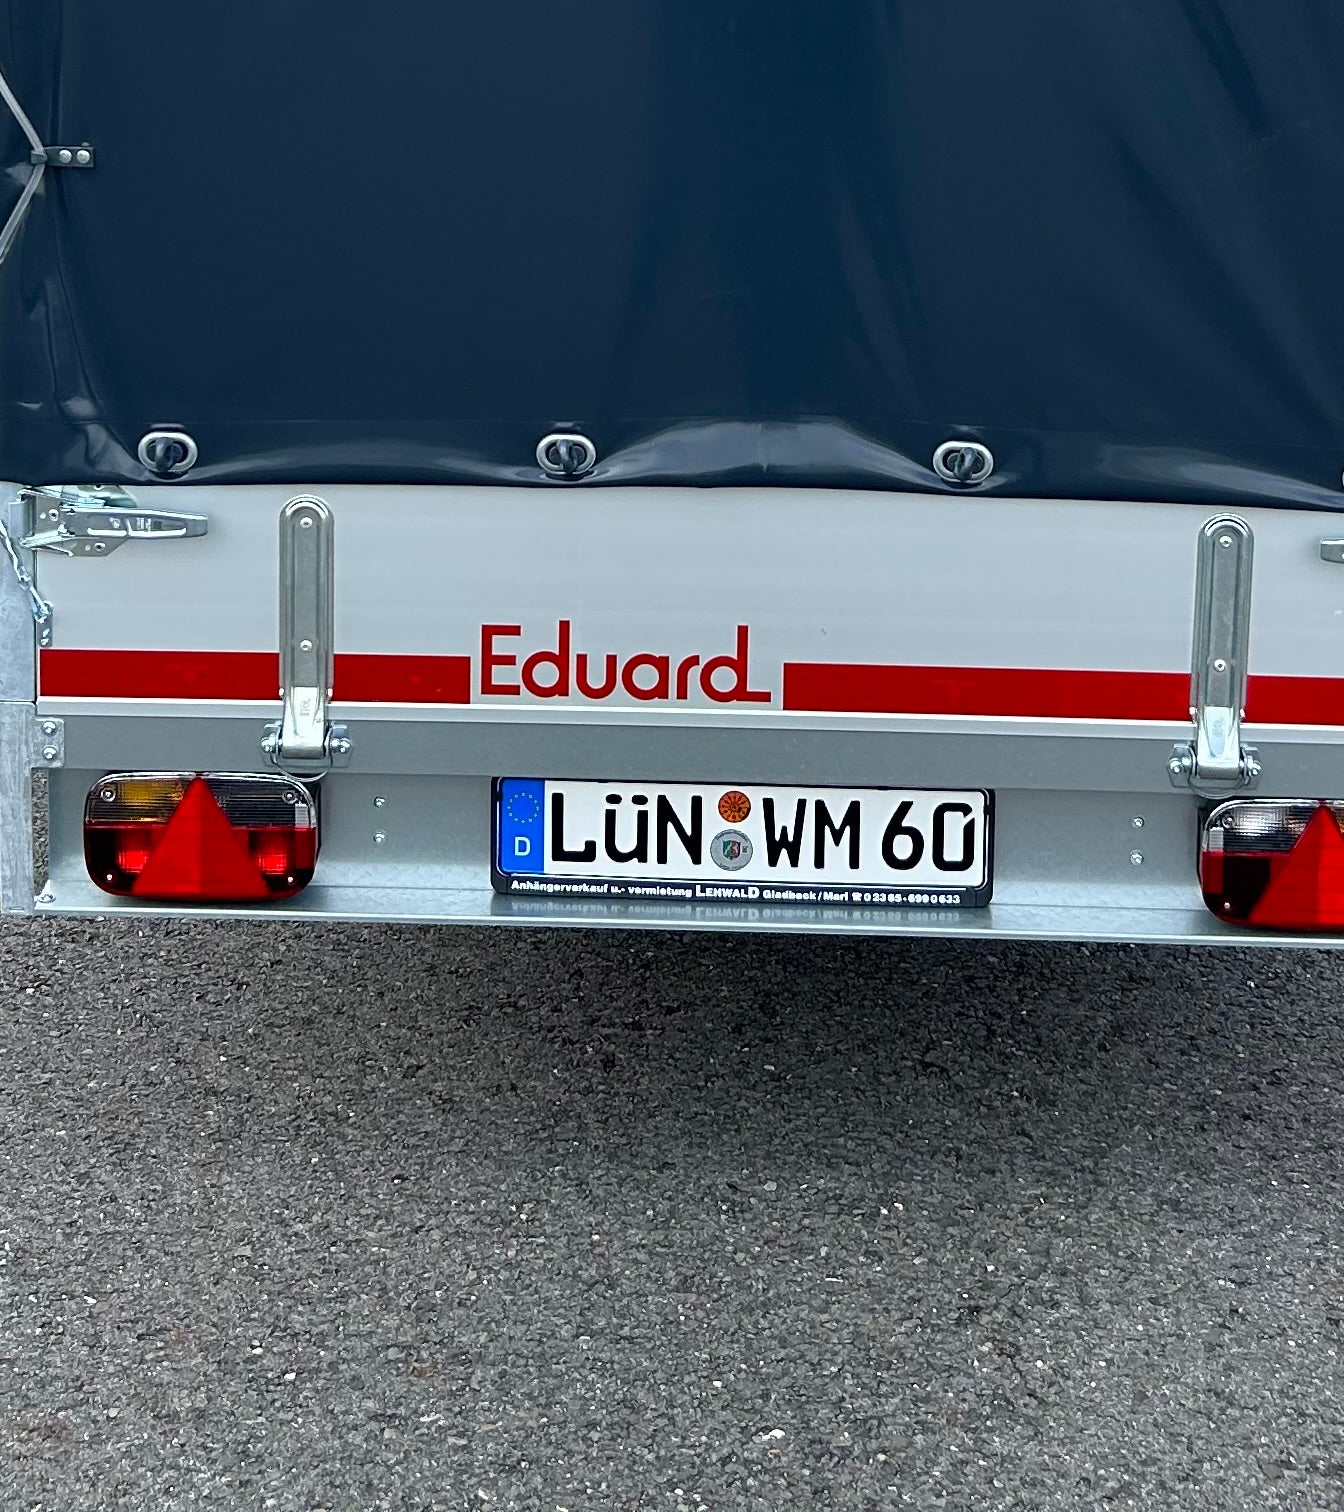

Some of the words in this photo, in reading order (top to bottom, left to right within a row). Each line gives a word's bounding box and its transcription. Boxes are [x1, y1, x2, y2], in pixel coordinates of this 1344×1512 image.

[481, 620, 771, 703] Eduard
[514, 836, 531, 856] D
[551, 792, 703, 865] LÜN
[762, 797, 861, 870] WM
[881, 800, 975, 872] 60
[511, 880, 608, 893] Anhängerverkauf
[628, 886, 692, 898] vermietung
